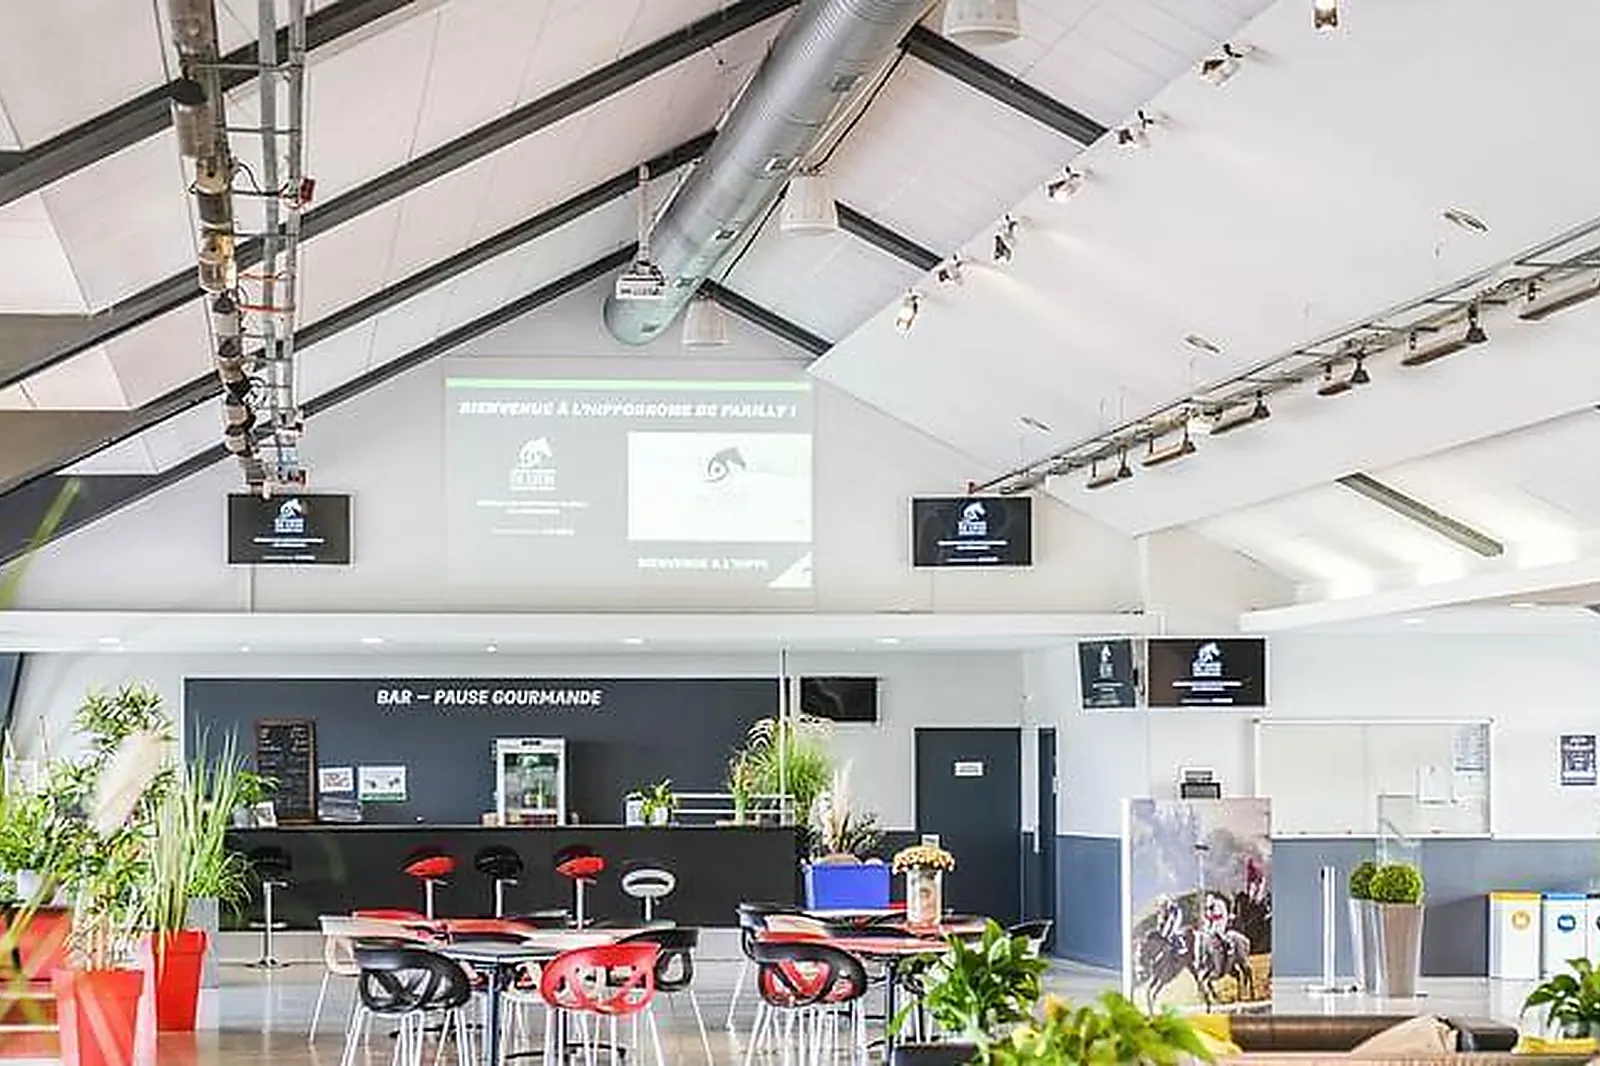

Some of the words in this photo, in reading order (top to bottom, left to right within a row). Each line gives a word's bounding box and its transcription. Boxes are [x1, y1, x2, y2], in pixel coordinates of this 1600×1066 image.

[377, 689, 413, 705] BAR
[433, 689, 489, 705] PAUSE
[491, 689, 603, 706] GOURMANDE
